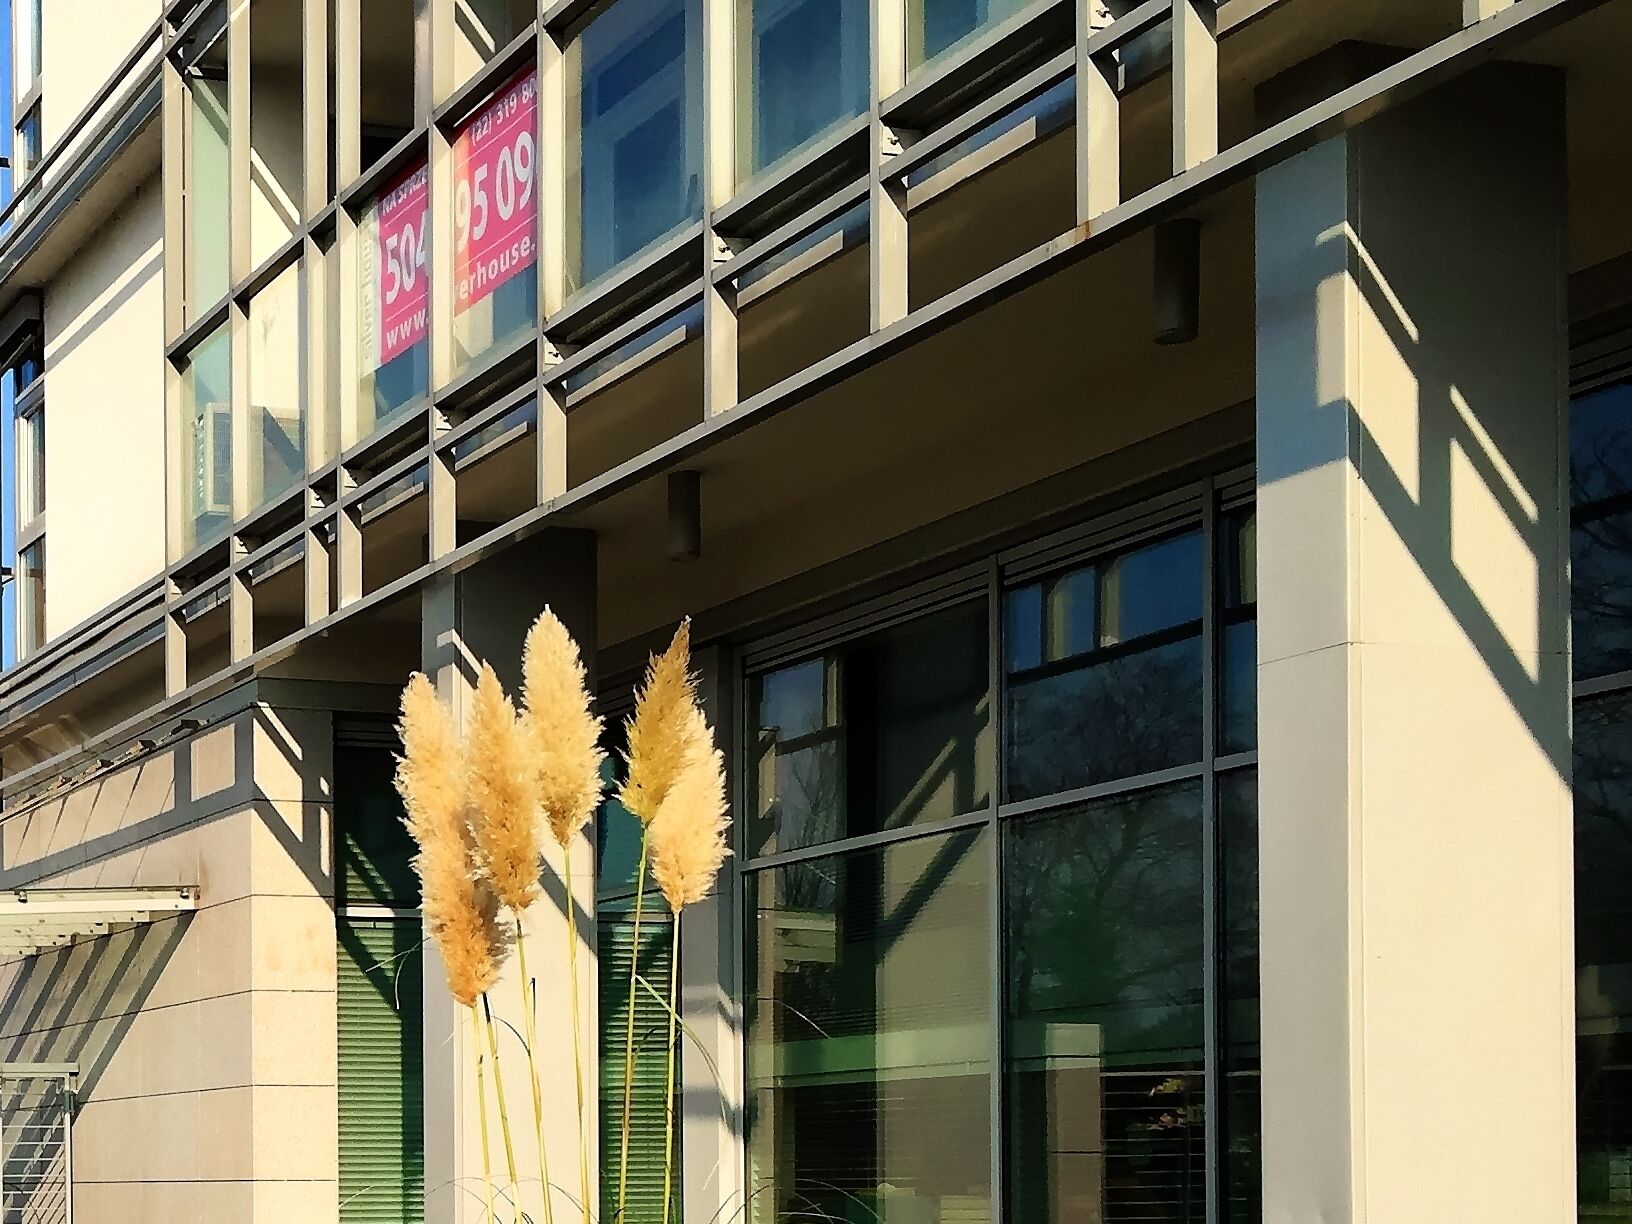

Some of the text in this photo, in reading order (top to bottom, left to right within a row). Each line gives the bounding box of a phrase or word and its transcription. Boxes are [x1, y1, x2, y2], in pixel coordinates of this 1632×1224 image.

[471, 112, 492, 146] (22)
[496, 92, 517, 125] 319
[455, 235, 536, 300] erhouse.
